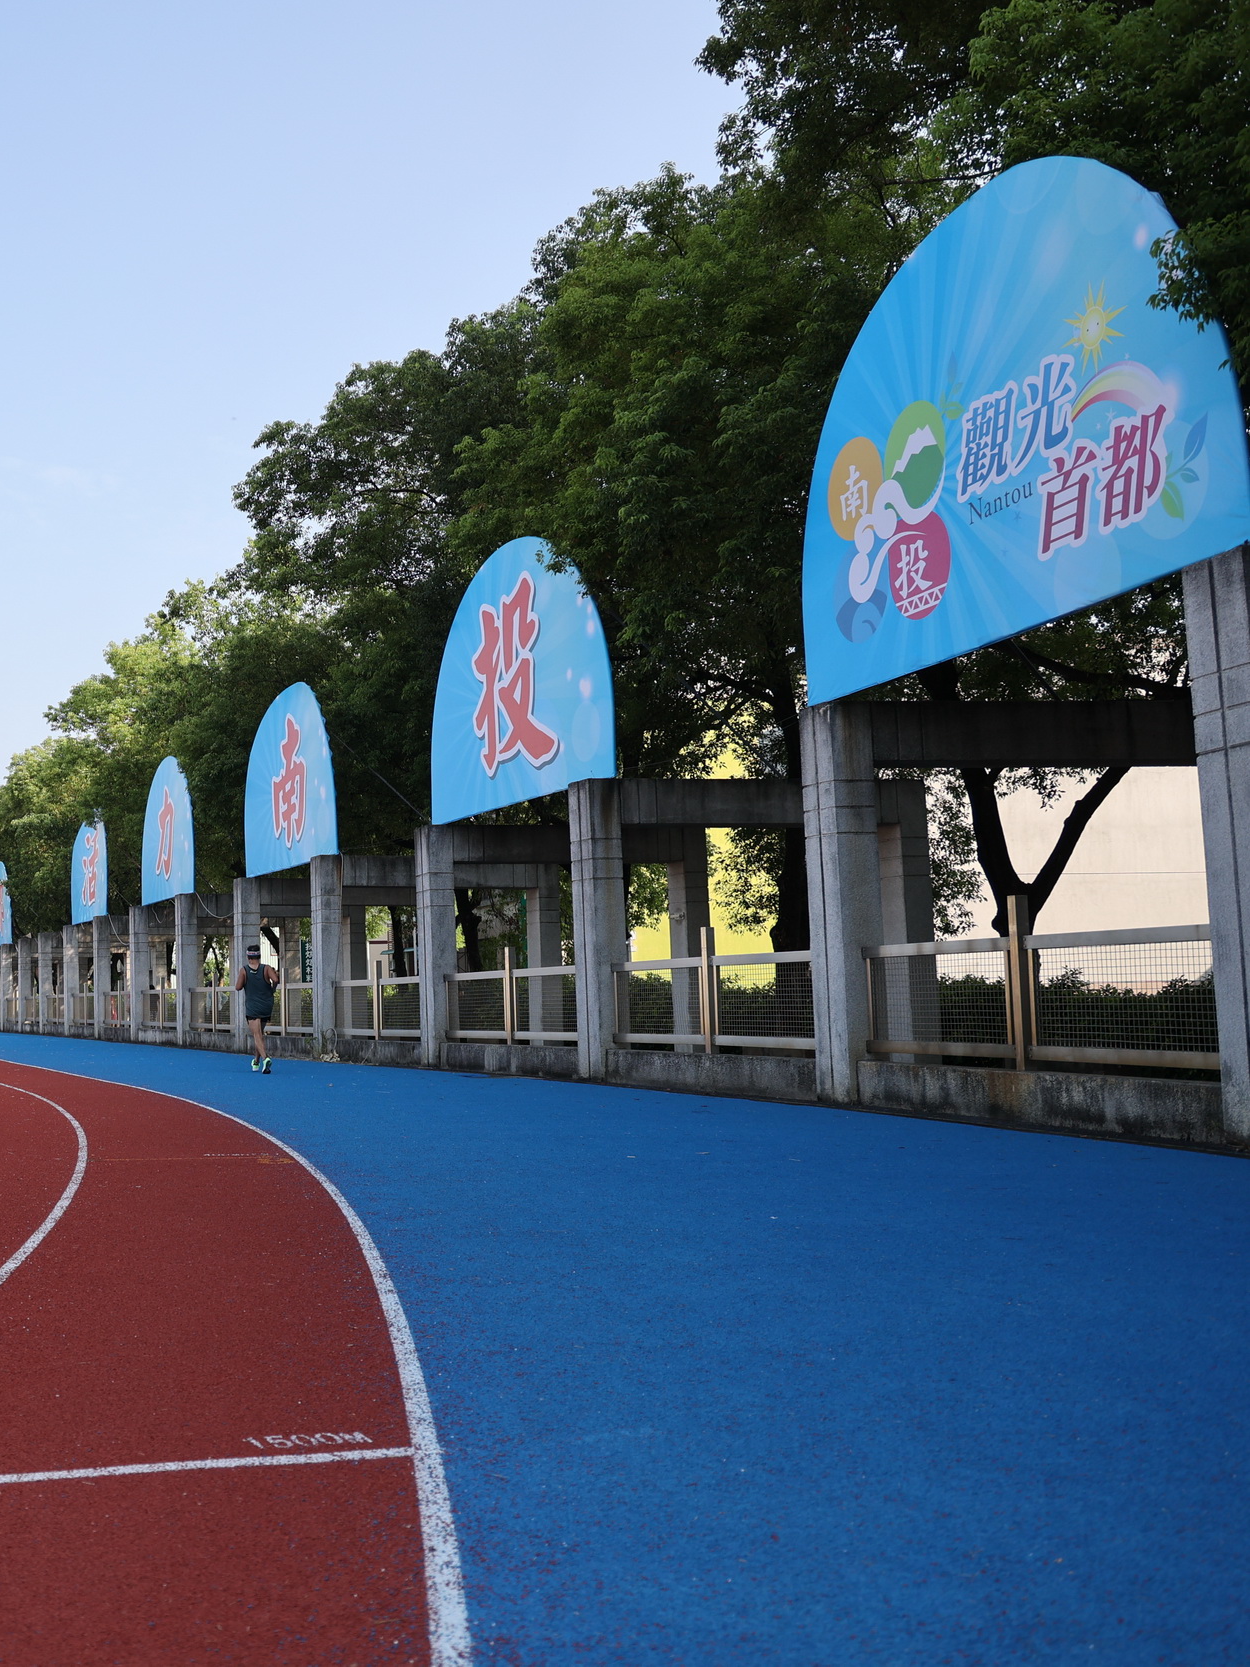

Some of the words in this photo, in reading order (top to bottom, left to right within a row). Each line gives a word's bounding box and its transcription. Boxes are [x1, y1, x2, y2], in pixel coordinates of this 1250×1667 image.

[959, 357, 1074, 500] 觀光
[1039, 402, 1169, 557] 首都
[839, 465, 869, 521] 南
[894, 539, 934, 598] 投
[966, 480, 1033, 525] Nantou
[473, 570, 558, 777] 投
[156, 787, 175, 880] 力
[272, 712, 307, 848] 南
[242, 1431, 374, 1449] 1500M
